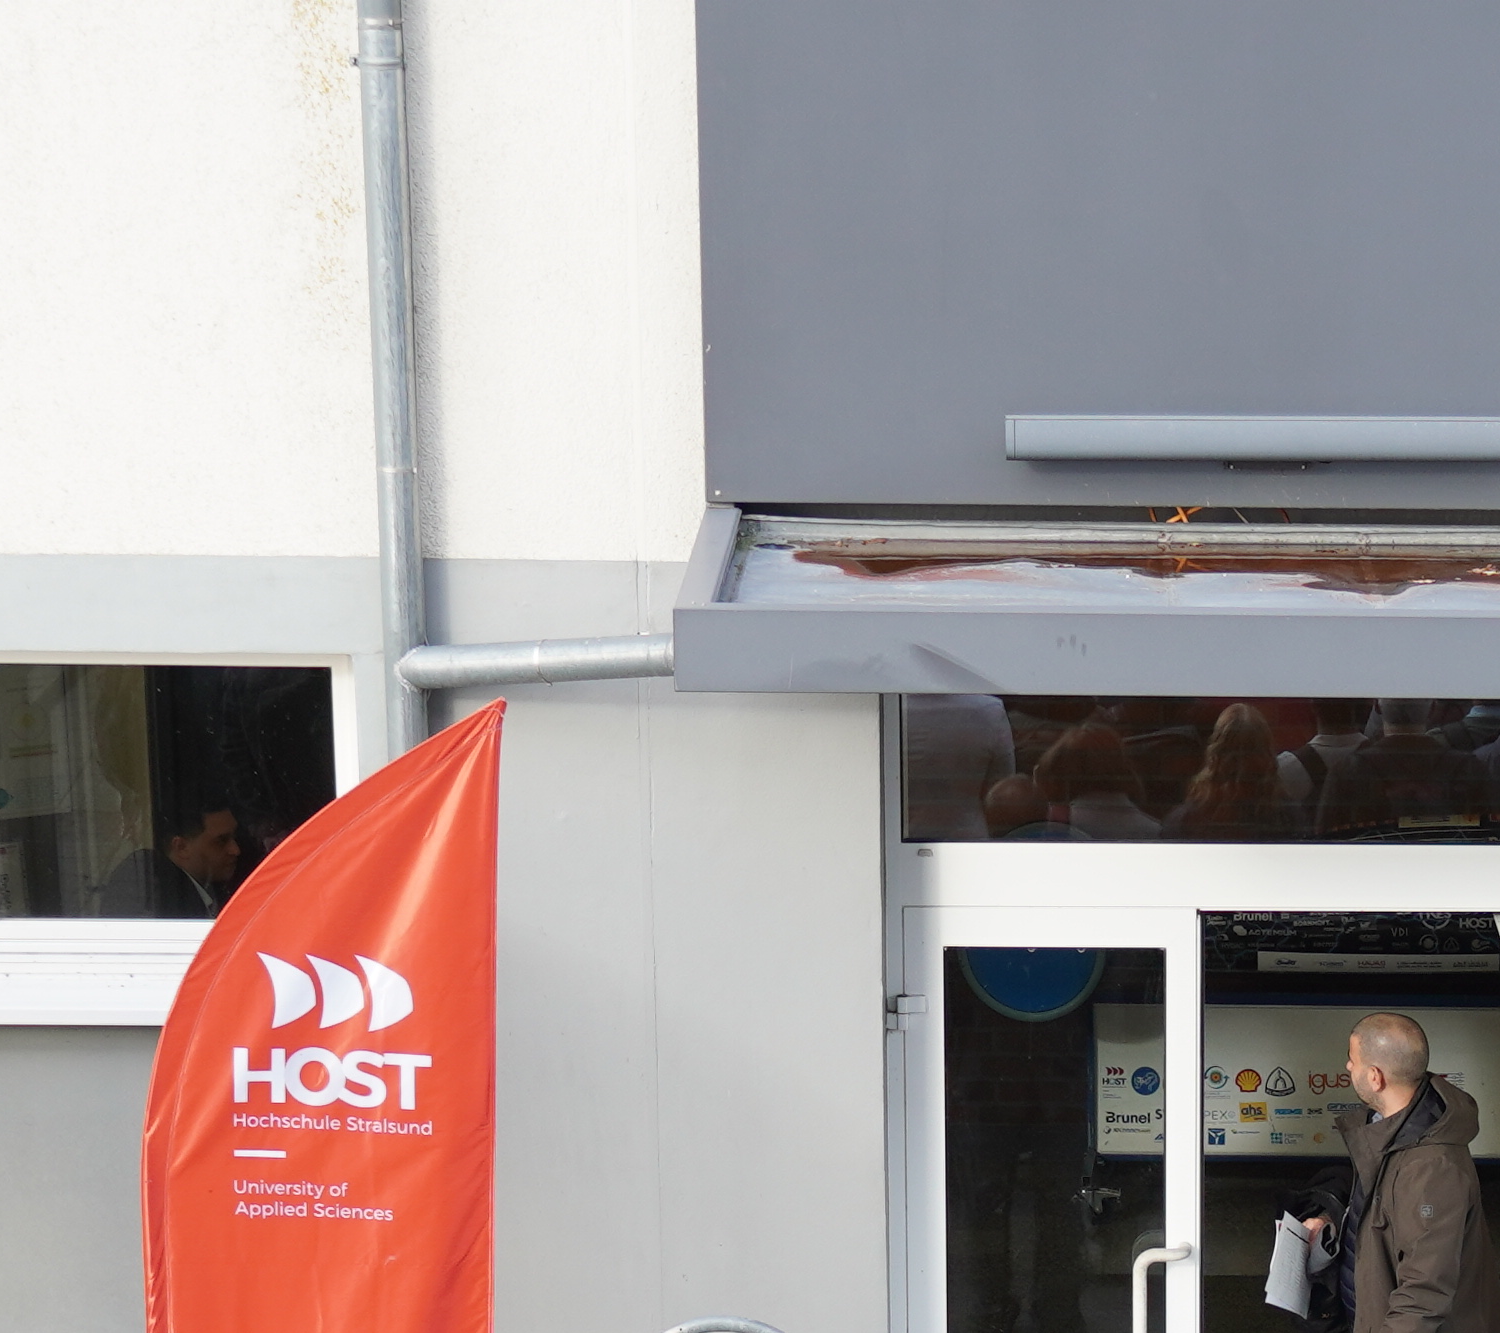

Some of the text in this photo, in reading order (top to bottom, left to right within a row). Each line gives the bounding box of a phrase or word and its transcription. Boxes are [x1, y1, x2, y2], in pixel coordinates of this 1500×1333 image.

[1459, 917, 1495, 929] HOST
[1390, 927, 1409, 937] VDI
[232, 1046, 433, 1111] HOST
[1102, 1077, 1128, 1086] HOST
[1308, 1070, 1352, 1095] igus
[1204, 1109, 1228, 1121] PEX
[1240, 1103, 1263, 1116] ahs
[233, 1112, 434, 1136] Hochschule Stralsund
[1105, 1111, 1151, 1124] Brunel
[233, 1179, 349, 1200] University of
[234, 1200, 394, 1221] Applied Sciences
